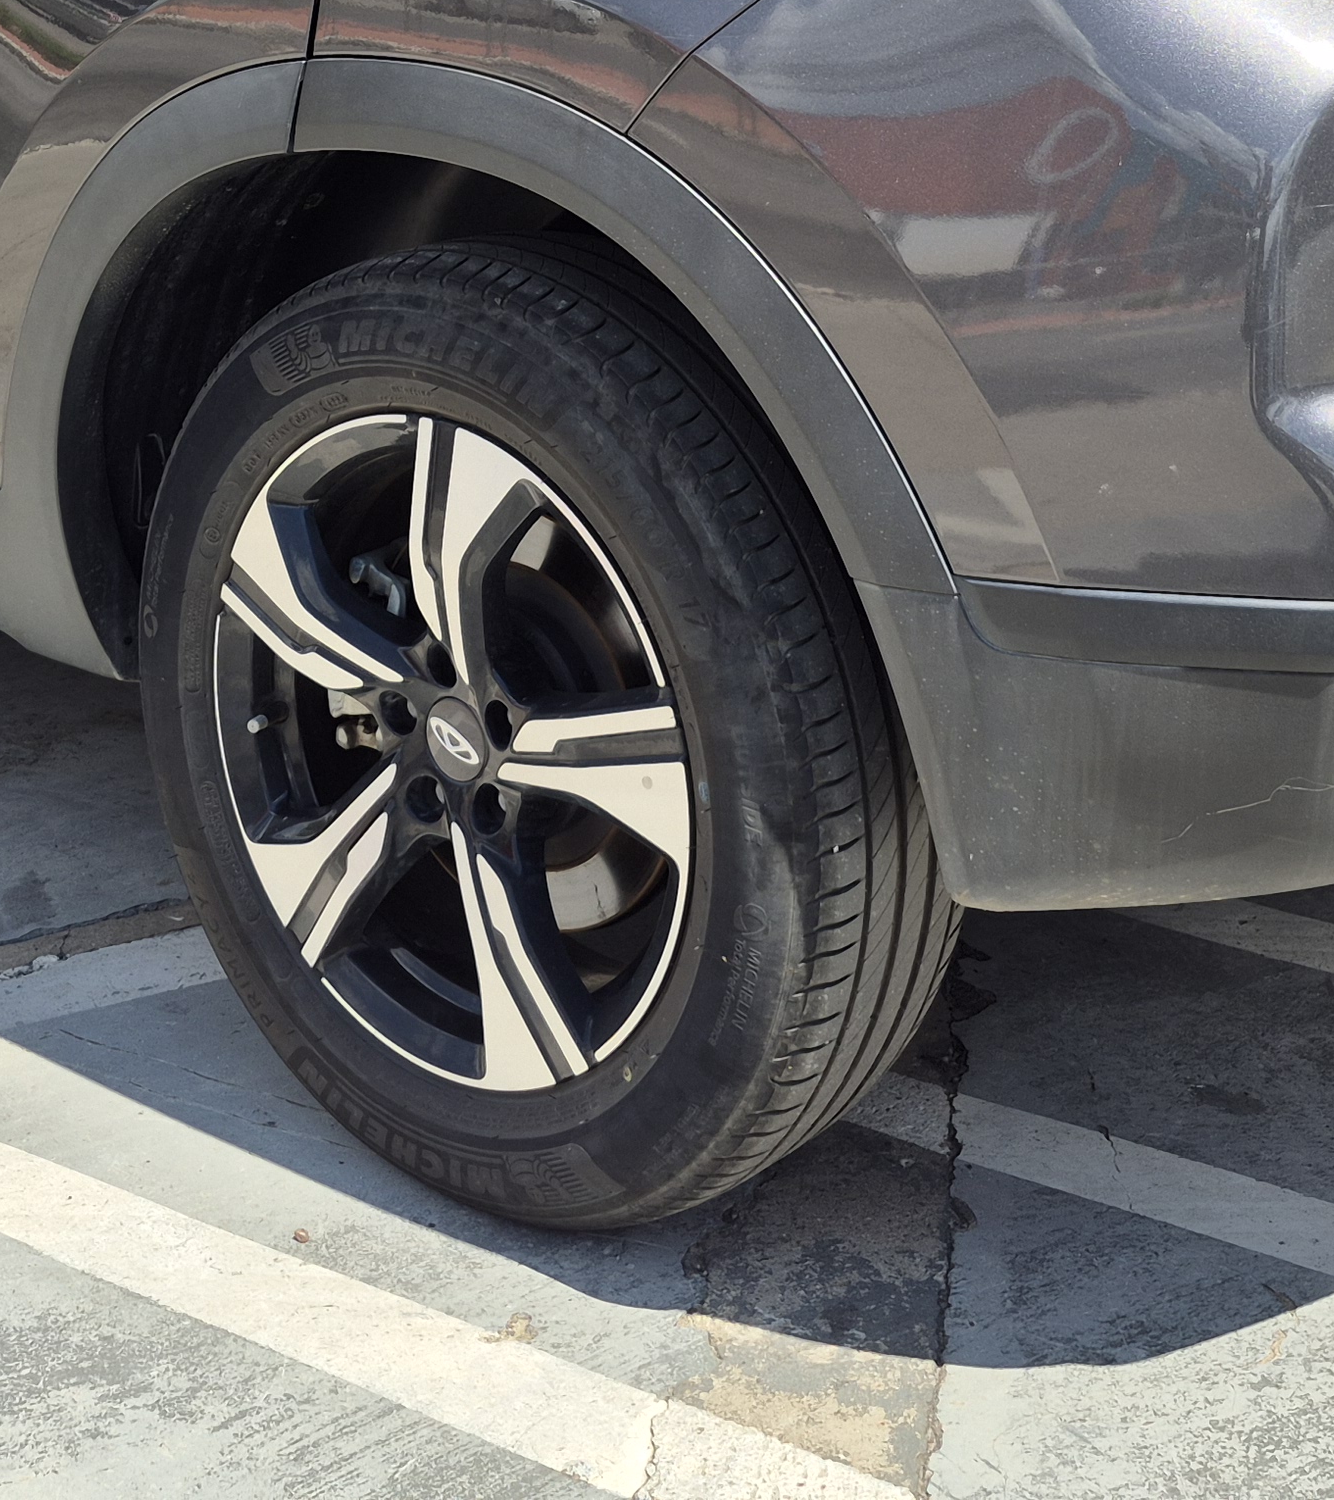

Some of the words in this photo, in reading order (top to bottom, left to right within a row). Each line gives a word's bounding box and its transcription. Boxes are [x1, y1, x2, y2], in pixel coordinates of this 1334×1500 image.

[339, 318, 561, 419] MICHELIN
[198, 894, 273, 1029] PRIMACY
[731, 946, 762, 1032] MICHELIN
[296, 1055, 508, 1200] MICHELIN
